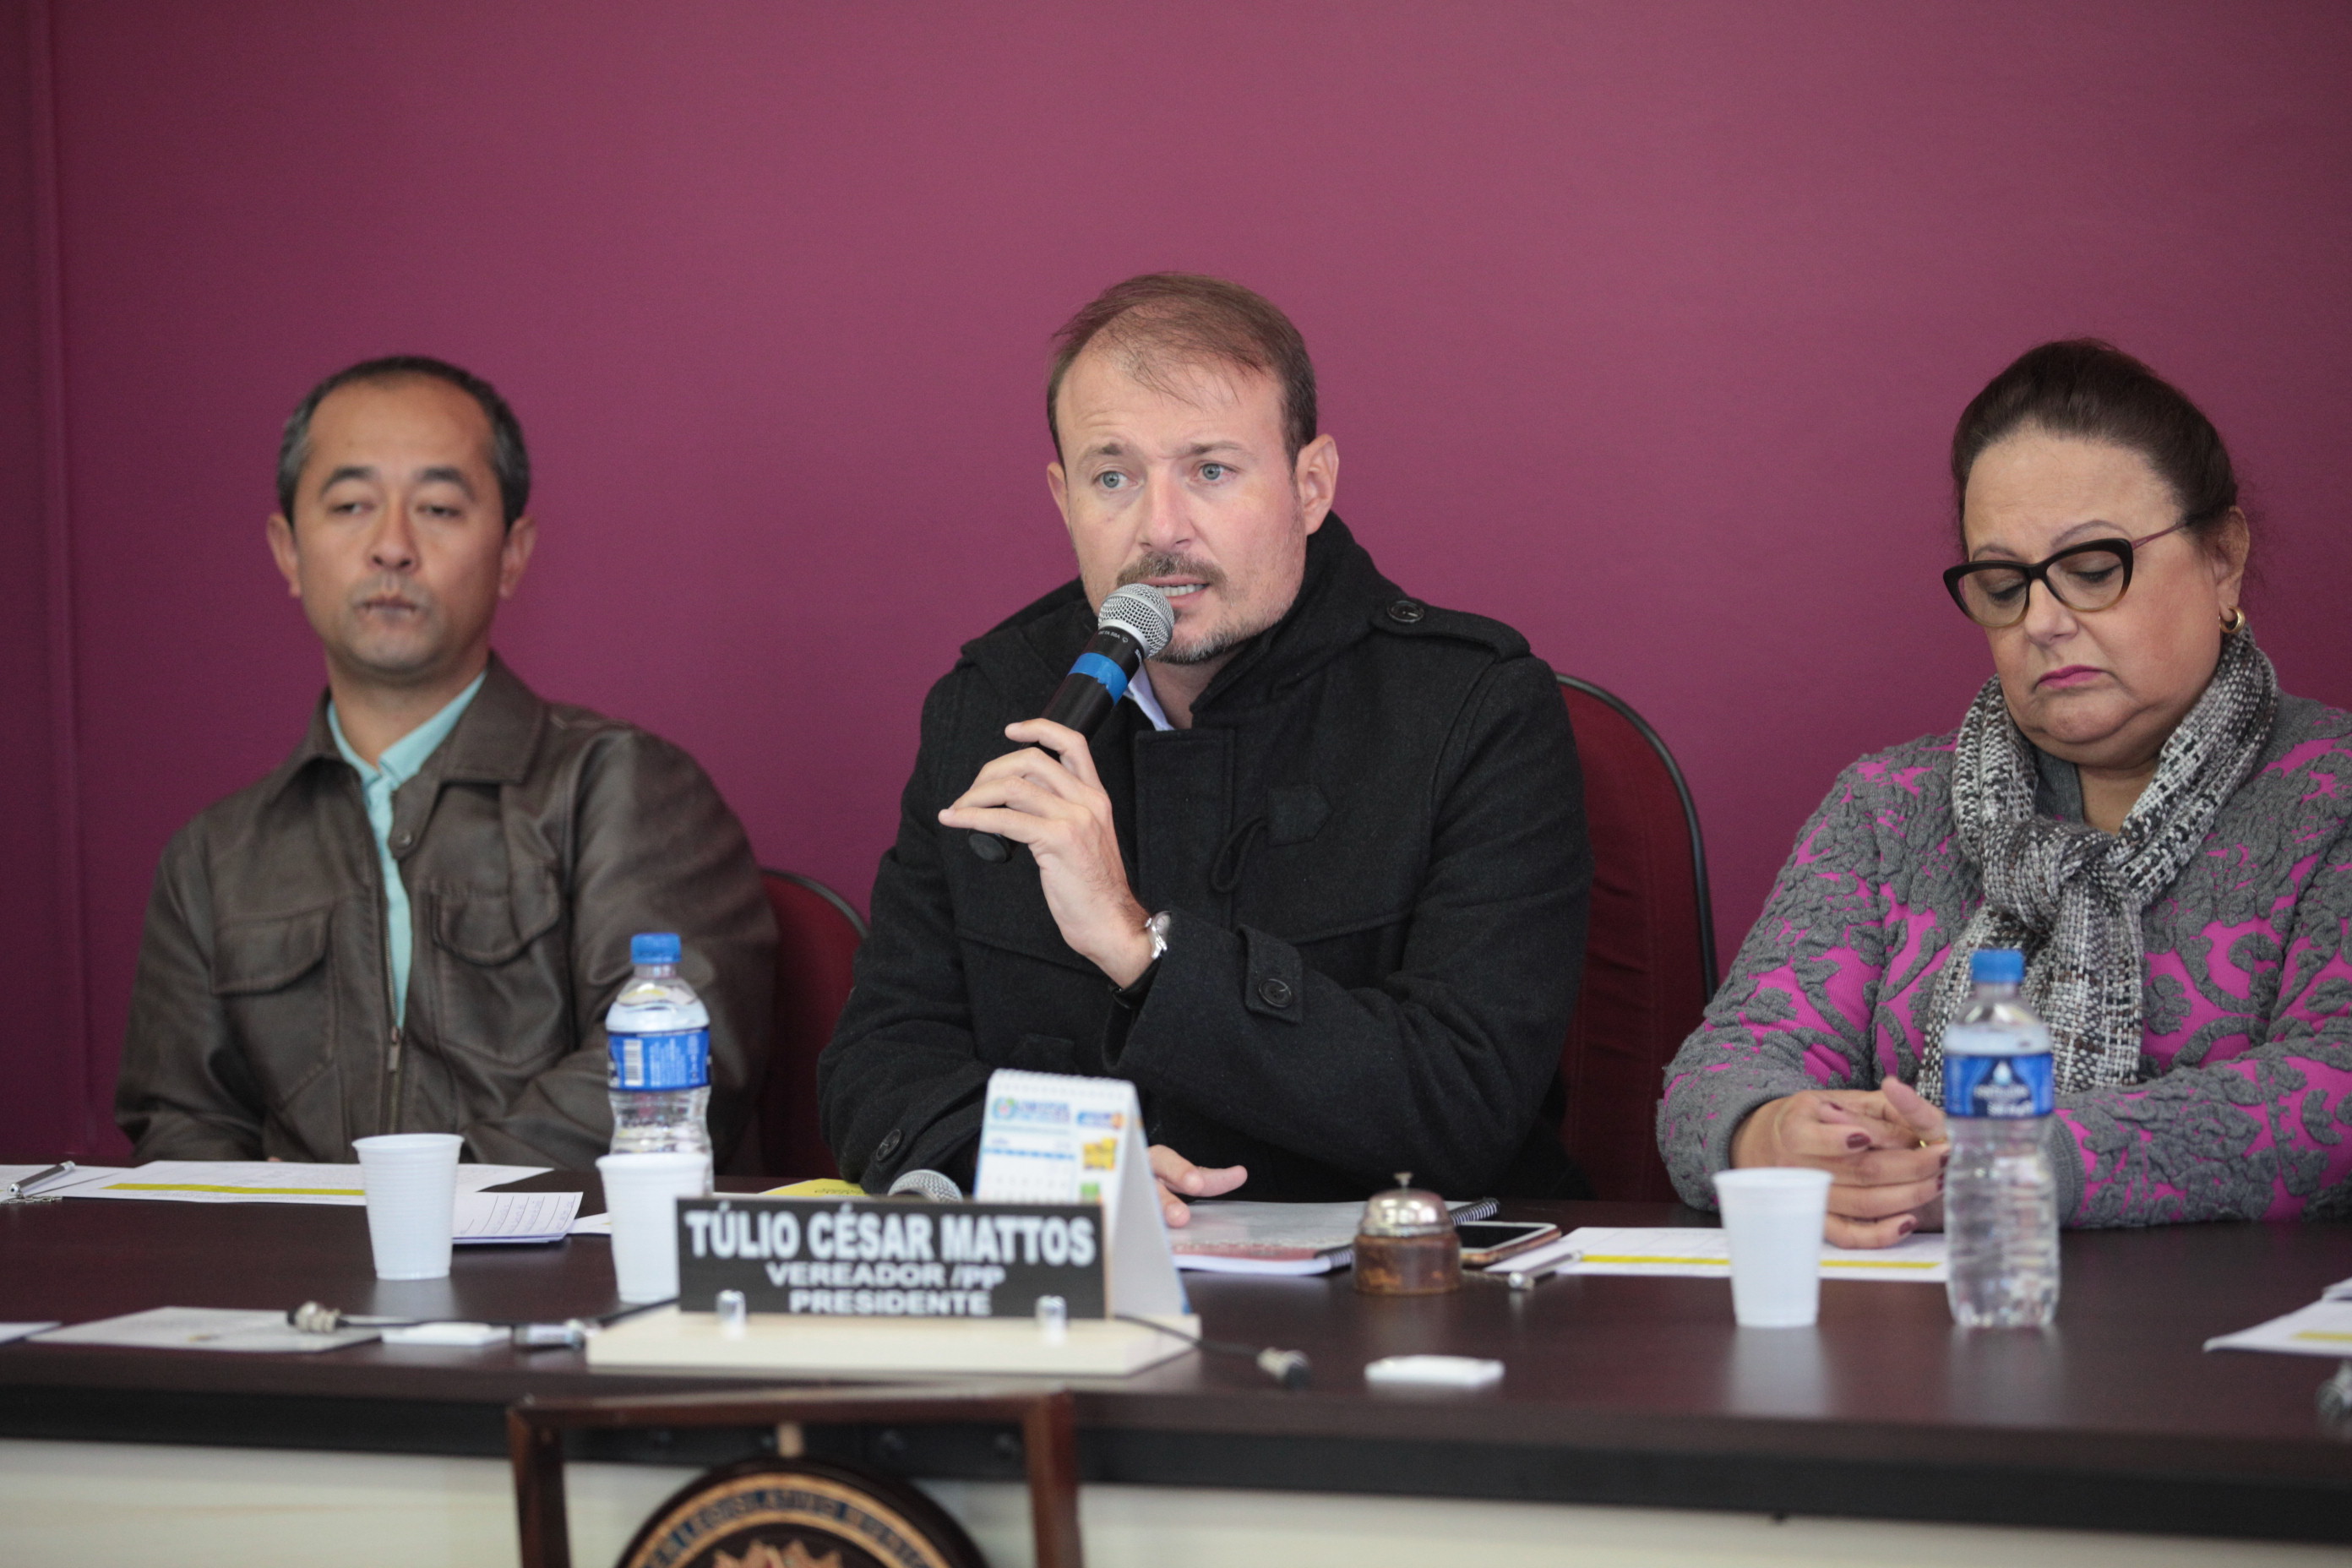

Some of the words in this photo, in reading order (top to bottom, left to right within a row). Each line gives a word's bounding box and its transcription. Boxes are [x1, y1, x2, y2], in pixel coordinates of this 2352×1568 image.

[684, 1200, 801, 1259] TÚLIO
[807, 1202, 934, 1261] CÉSAR
[940, 1214, 1096, 1266] MATTOS
[765, 1260, 945, 1288] VEREADOR
[789, 1288, 993, 1315] PRESIDENTE
